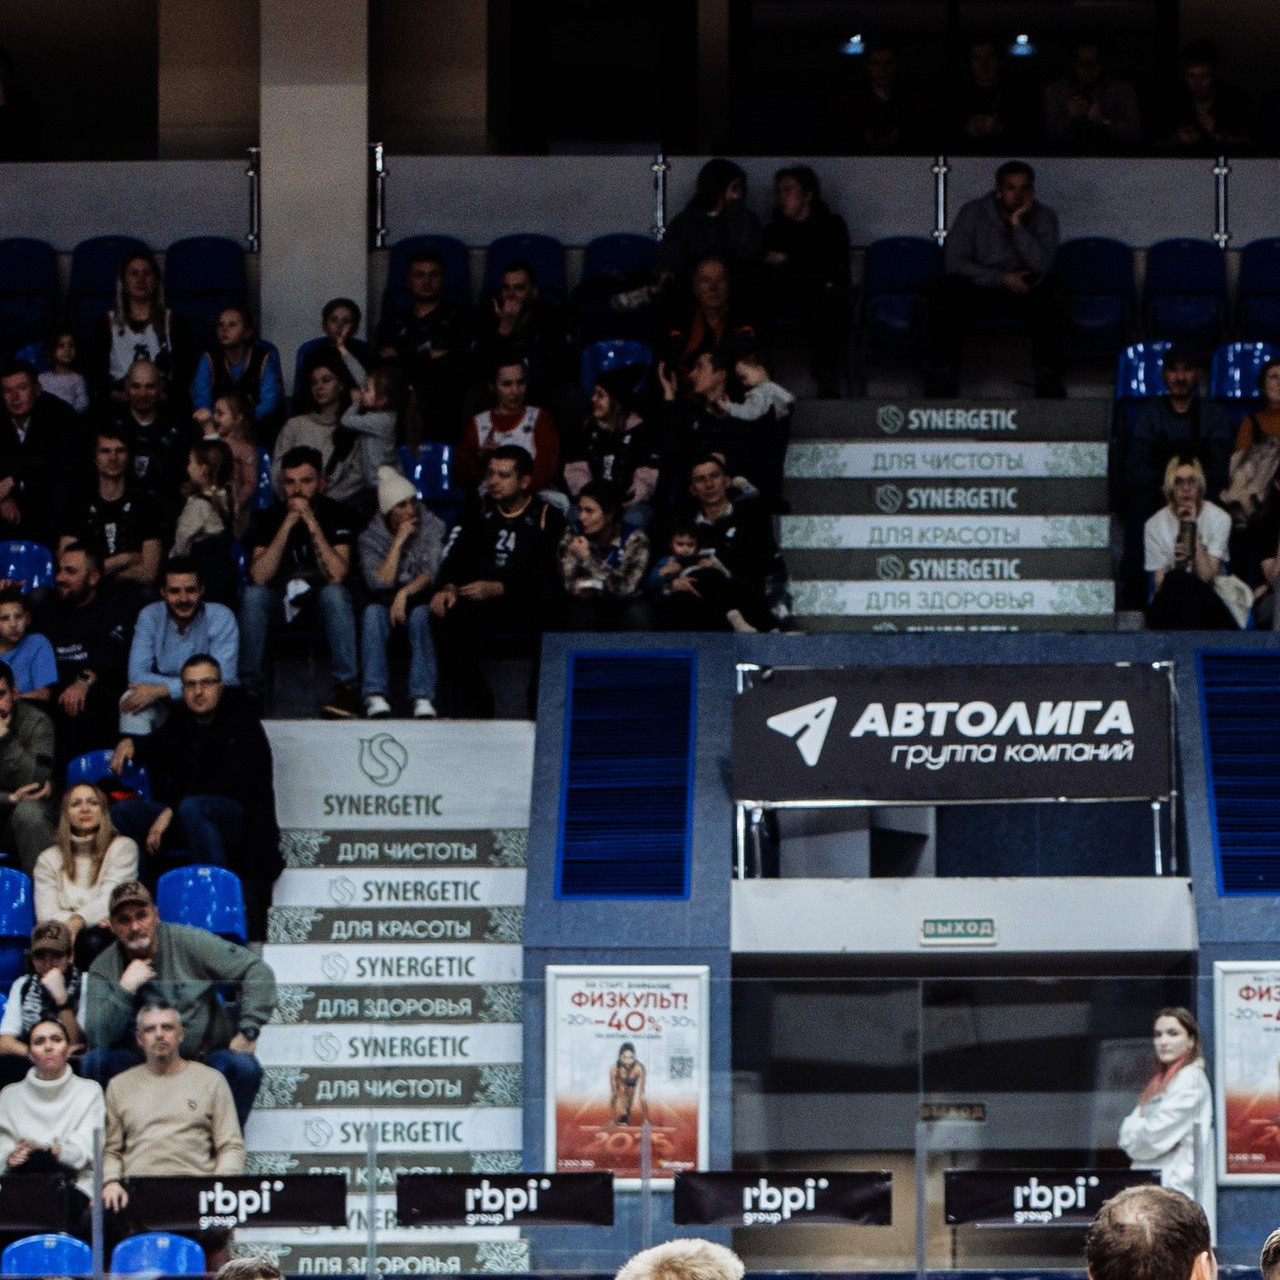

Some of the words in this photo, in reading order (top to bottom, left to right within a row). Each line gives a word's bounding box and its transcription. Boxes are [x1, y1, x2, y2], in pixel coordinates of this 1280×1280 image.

[908, 409, 1017, 430] SYNERGETIC
[872, 452, 916, 472] ДЛЯ
[922, 452, 1024, 471] ЧИСТОТЫ
[907, 487, 1017, 509] SYNERGETIC
[869, 527, 913, 546] ДЛЯ
[918, 526, 1021, 545] КРАСОТЫ
[909, 558, 1021, 581] SYNERGETIC
[866, 591, 912, 612] ДЛЯ
[917, 590, 1035, 611] ЗДОРОВЬЯ
[850, 700, 1135, 738] АВТОЛИГА
[891, 745, 997, 771] группа
[1004, 739, 1135, 763] компаний
[323, 794, 443, 816] SYNERGETIC
[337, 843, 379, 862] ДЛЯ
[382, 842, 477, 860] ЧИСТОТЫ
[363, 881, 480, 901] SYNERGETIC
[331, 920, 373, 940] ДЛЯ
[378, 919, 471, 938] КРАСОТЫ
[924, 921, 993, 935] ВЫХОД
[356, 957, 475, 977] SYNERGETIC
[316, 999, 359, 1019] ДЛЯ
[363, 998, 472, 1018] ЗДОРОВЬЯ
[571, 990, 688, 1010] ФИЗКУЛЬТ!
[348, 1036, 470, 1058] SYNERGETIC
[316, 1079, 360, 1100] ДЛЯ
[364, 1079, 462, 1098] ЧИСТОТЫ
[340, 1121, 463, 1143] SYNERGETIC
[199, 1215, 237, 1230] group
[466, 1213, 504, 1226] group
[743, 1210, 782, 1226] group
[1014, 1209, 1053, 1225] group
